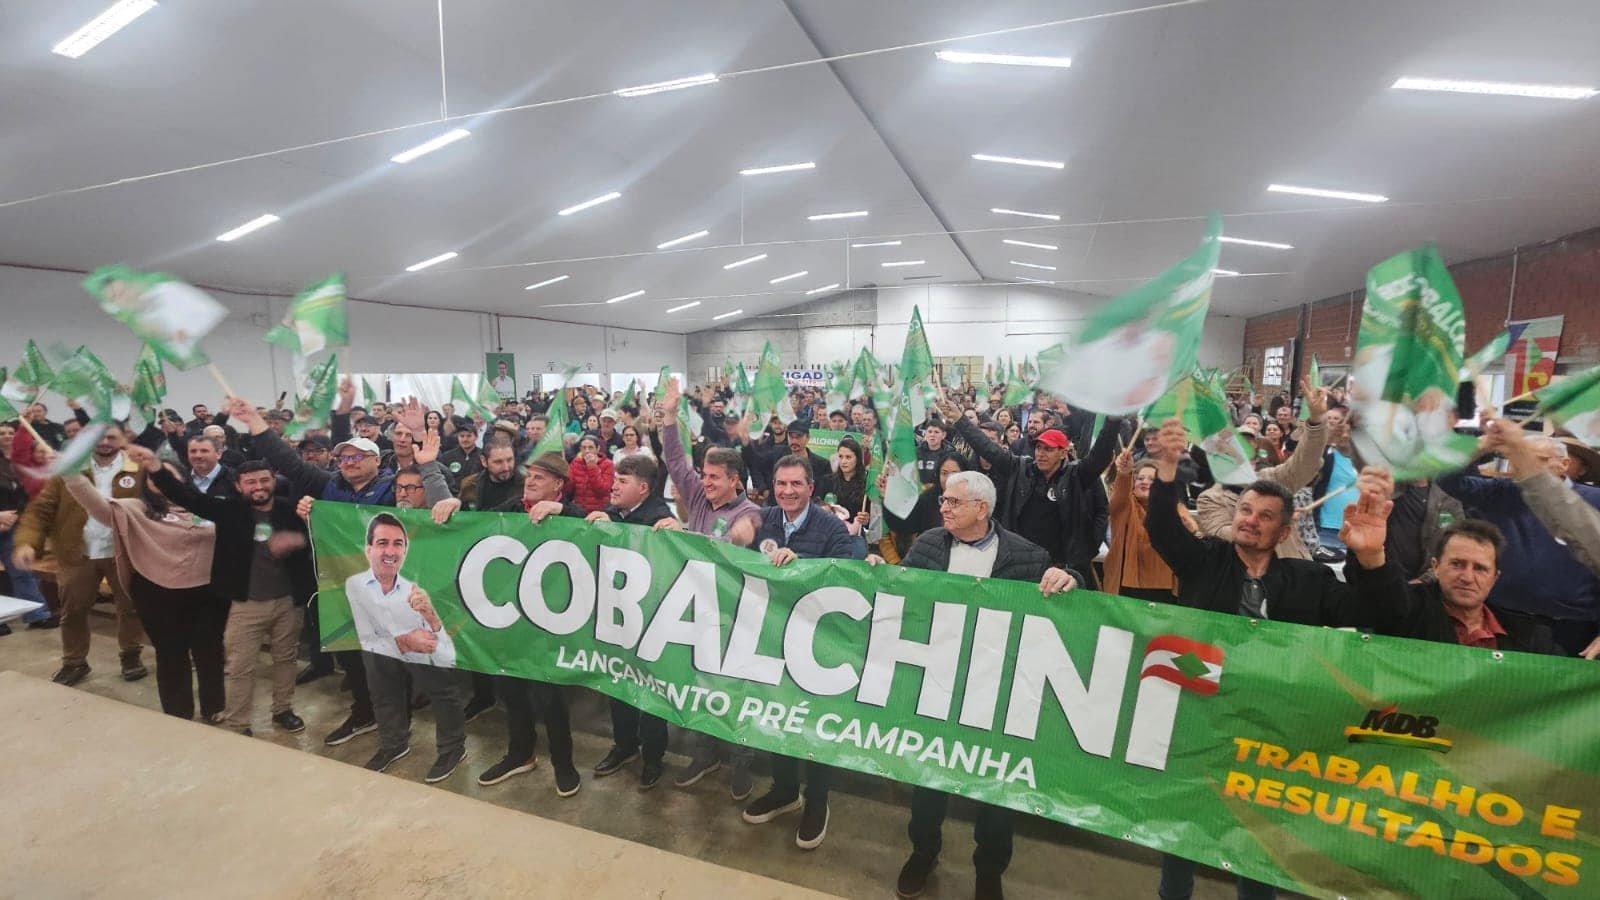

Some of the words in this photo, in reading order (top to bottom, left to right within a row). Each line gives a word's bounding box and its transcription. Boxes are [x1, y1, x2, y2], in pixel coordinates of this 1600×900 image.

[556, 646, 731, 717] LANÇAMENTO
[737, 696, 810, 735] PRÉ
[816, 713, 1037, 789] CAMPANHA
[1360, 704, 1439, 738] MDB
[1223, 771, 1582, 886] RESULTADOS
[1233, 737, 1524, 826] TRABALHO
[1541, 804, 1581, 840] E
